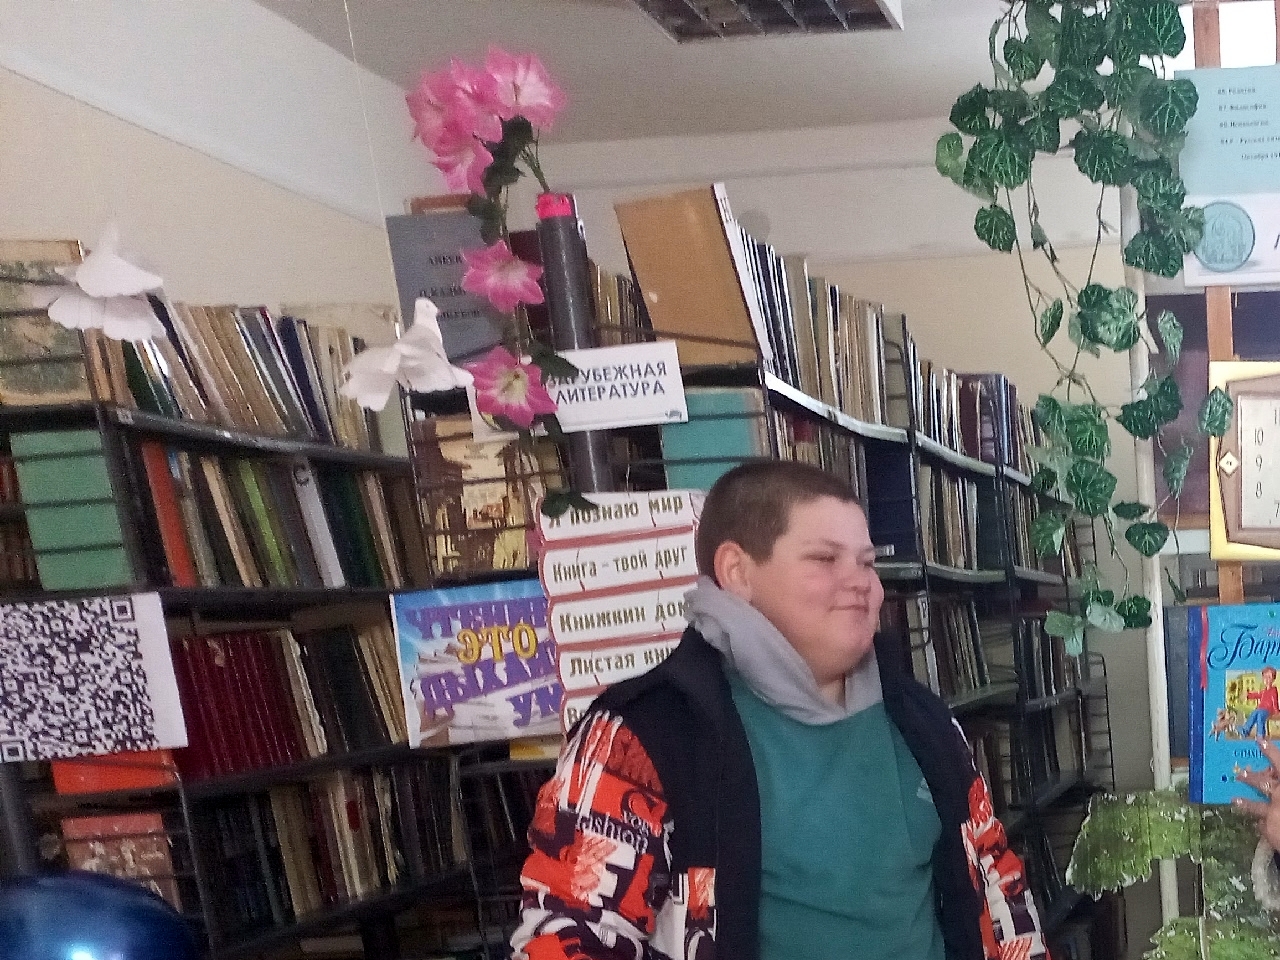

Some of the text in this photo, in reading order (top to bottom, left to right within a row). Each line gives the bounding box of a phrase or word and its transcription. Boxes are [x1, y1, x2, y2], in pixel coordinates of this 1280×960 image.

[556, 380, 665, 405] ЛИТЕРАТУРА
[1254, 427, 1265, 445] 10
[1255, 454, 1263, 472] 9
[1255, 481, 1263, 499] 8
[570, 502, 639, 525] познаю
[650, 495, 683, 516] мир
[1274, 500, 1280, 518] 7
[553, 560, 597, 584] Книга
[613, 551, 648, 574] твой
[655, 545, 688, 570] друг
[559, 604, 646, 633] Книжкин
[456, 622, 538, 666] ЭТО
[569, 652, 635, 677] Листая
